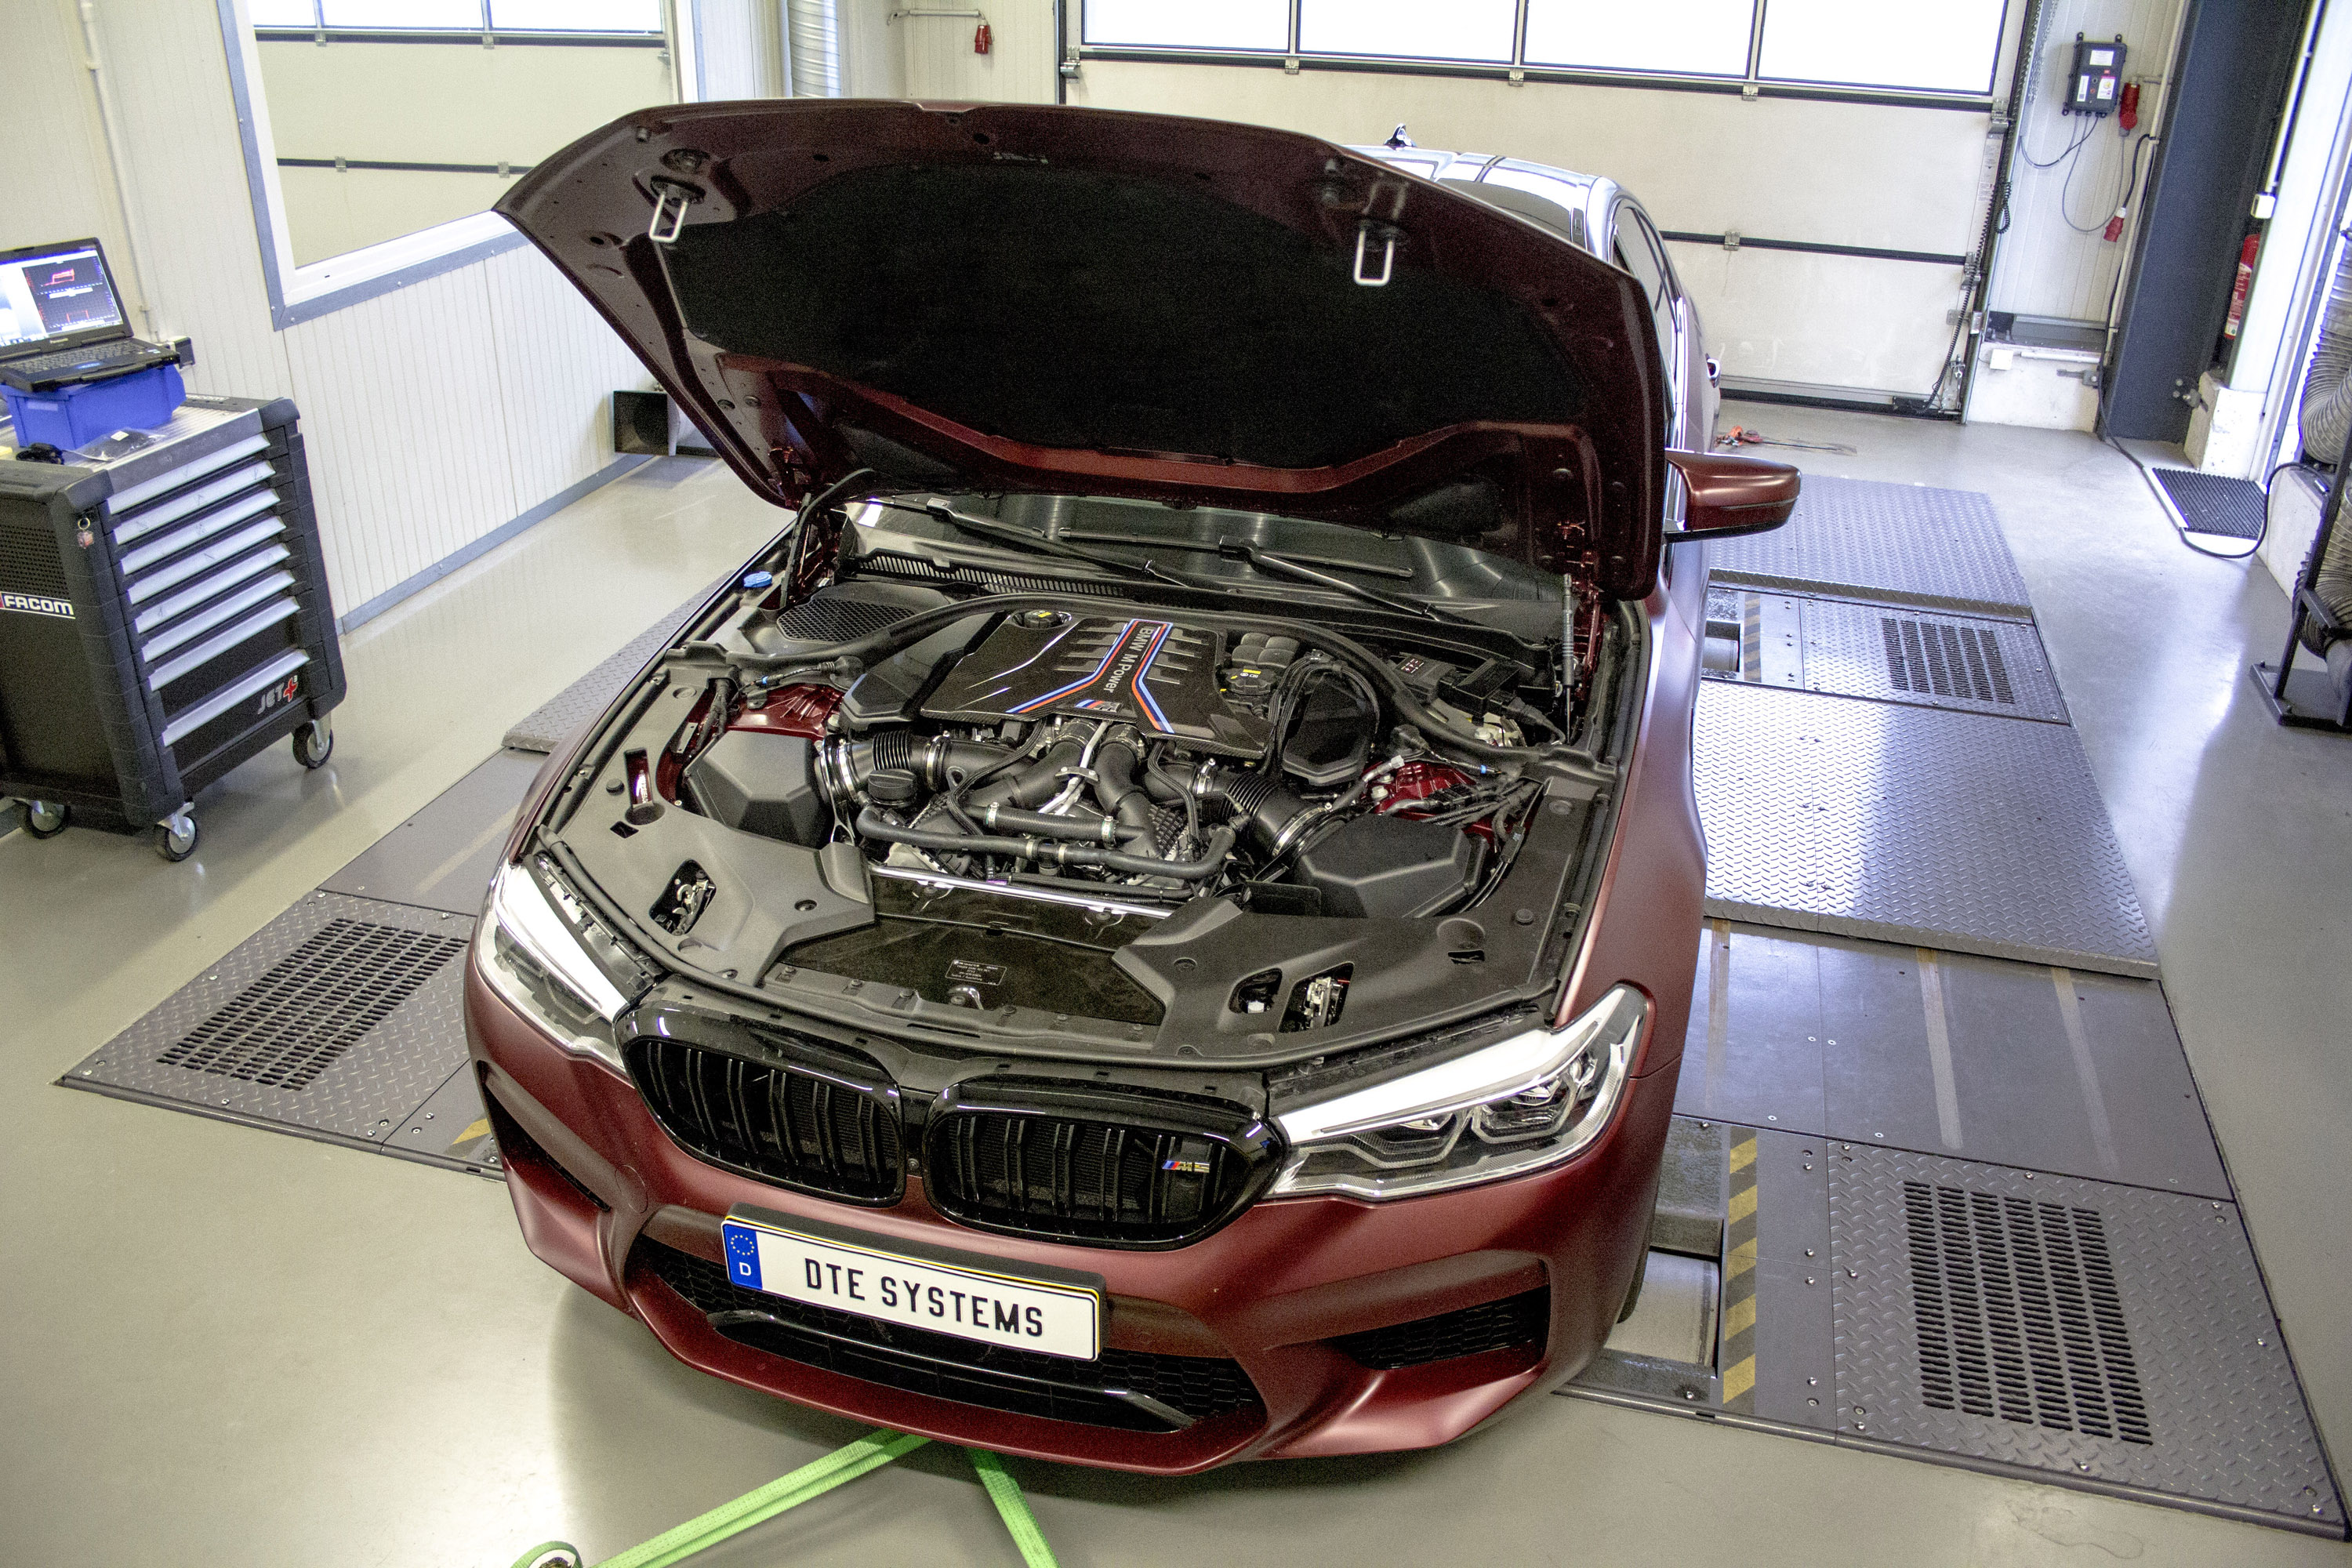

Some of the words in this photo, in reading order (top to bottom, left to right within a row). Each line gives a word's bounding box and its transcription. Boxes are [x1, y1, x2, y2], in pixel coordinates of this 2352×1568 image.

[3, 595, 74, 615] FACOM
[1129, 627, 1154, 652] BMW
[739, 1261, 752, 1276] D
[804, 1258, 866, 1301] DTE
[880, 1276, 1043, 1338] SYSTEMS
